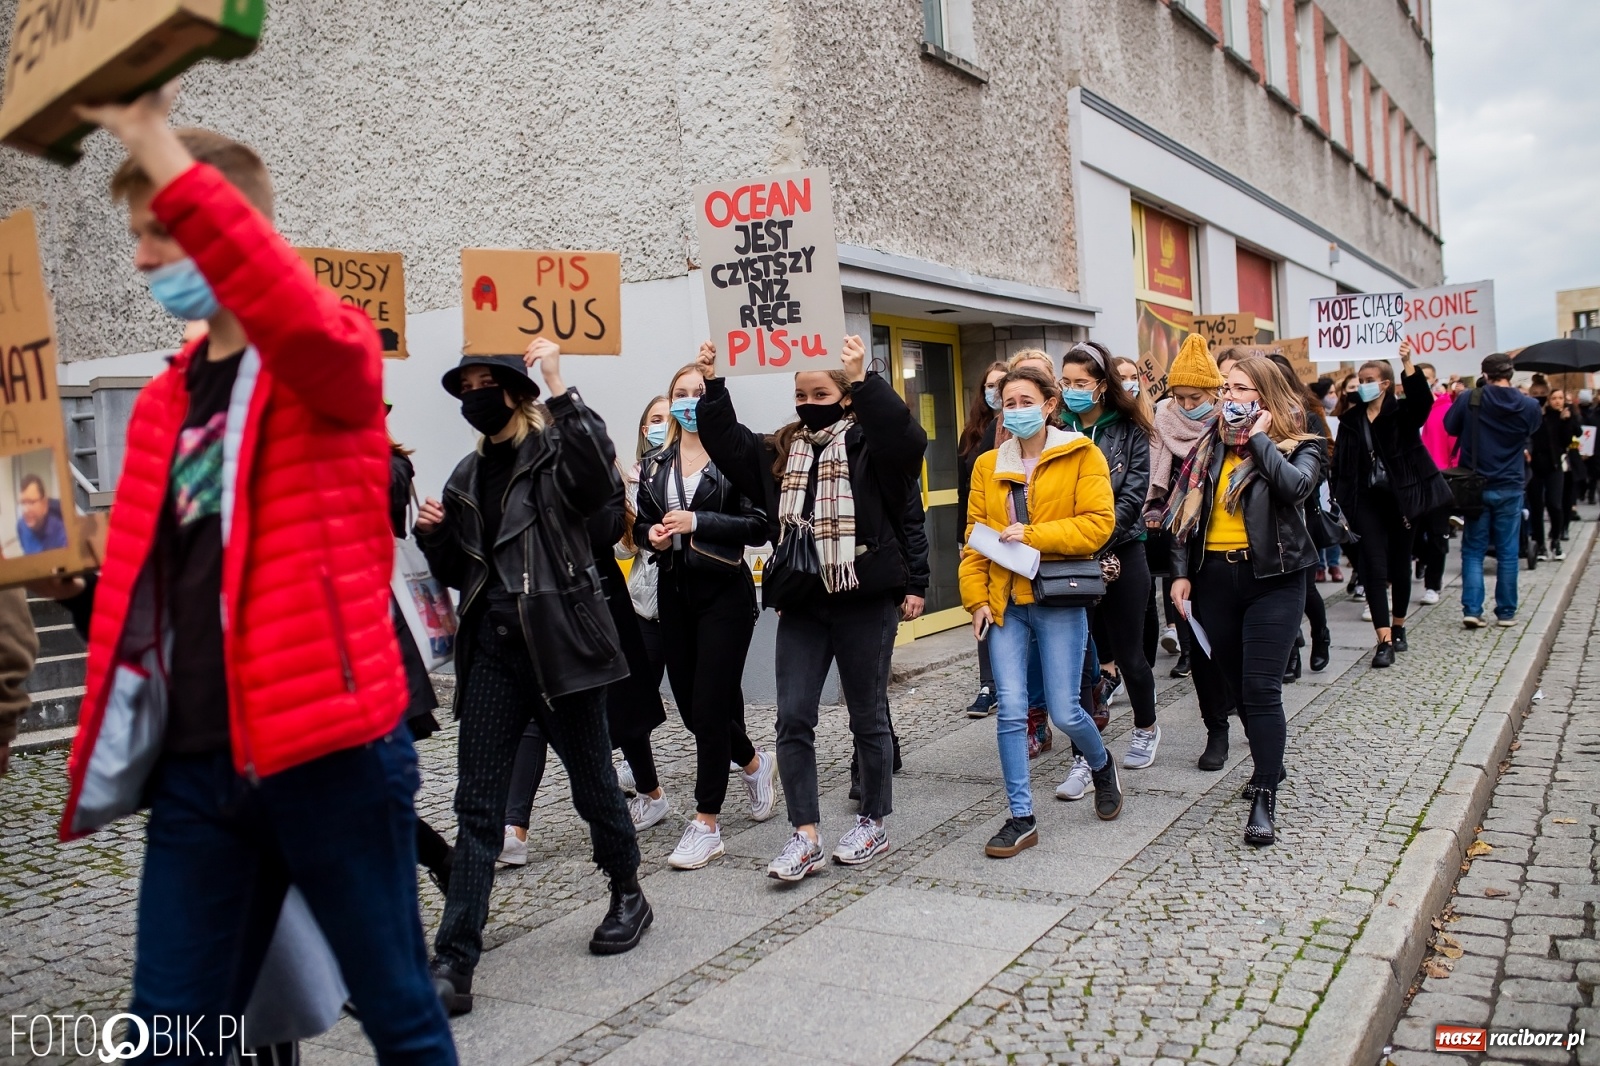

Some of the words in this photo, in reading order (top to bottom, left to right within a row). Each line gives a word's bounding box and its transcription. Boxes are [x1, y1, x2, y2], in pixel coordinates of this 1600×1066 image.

[704, 178, 813, 229] OCEAN
[735, 219, 793, 256] JEST
[314, 257, 390, 292] PUSSY
[537, 256, 590, 292] PIS
[711, 246, 816, 290] CZYSTSZY
[517, 296, 606, 341] SUS
[740, 301, 802, 332] RĘCE
[1193, 316, 1237, 336] TWÓJ
[1318, 297, 1360, 323] MOJE
[1362, 293, 1404, 318] CIAŁO
[727, 328, 827, 368] PIS-u
[1318, 323, 1351, 349] MÓJ
[1356, 319, 1404, 344] WYBÓR
